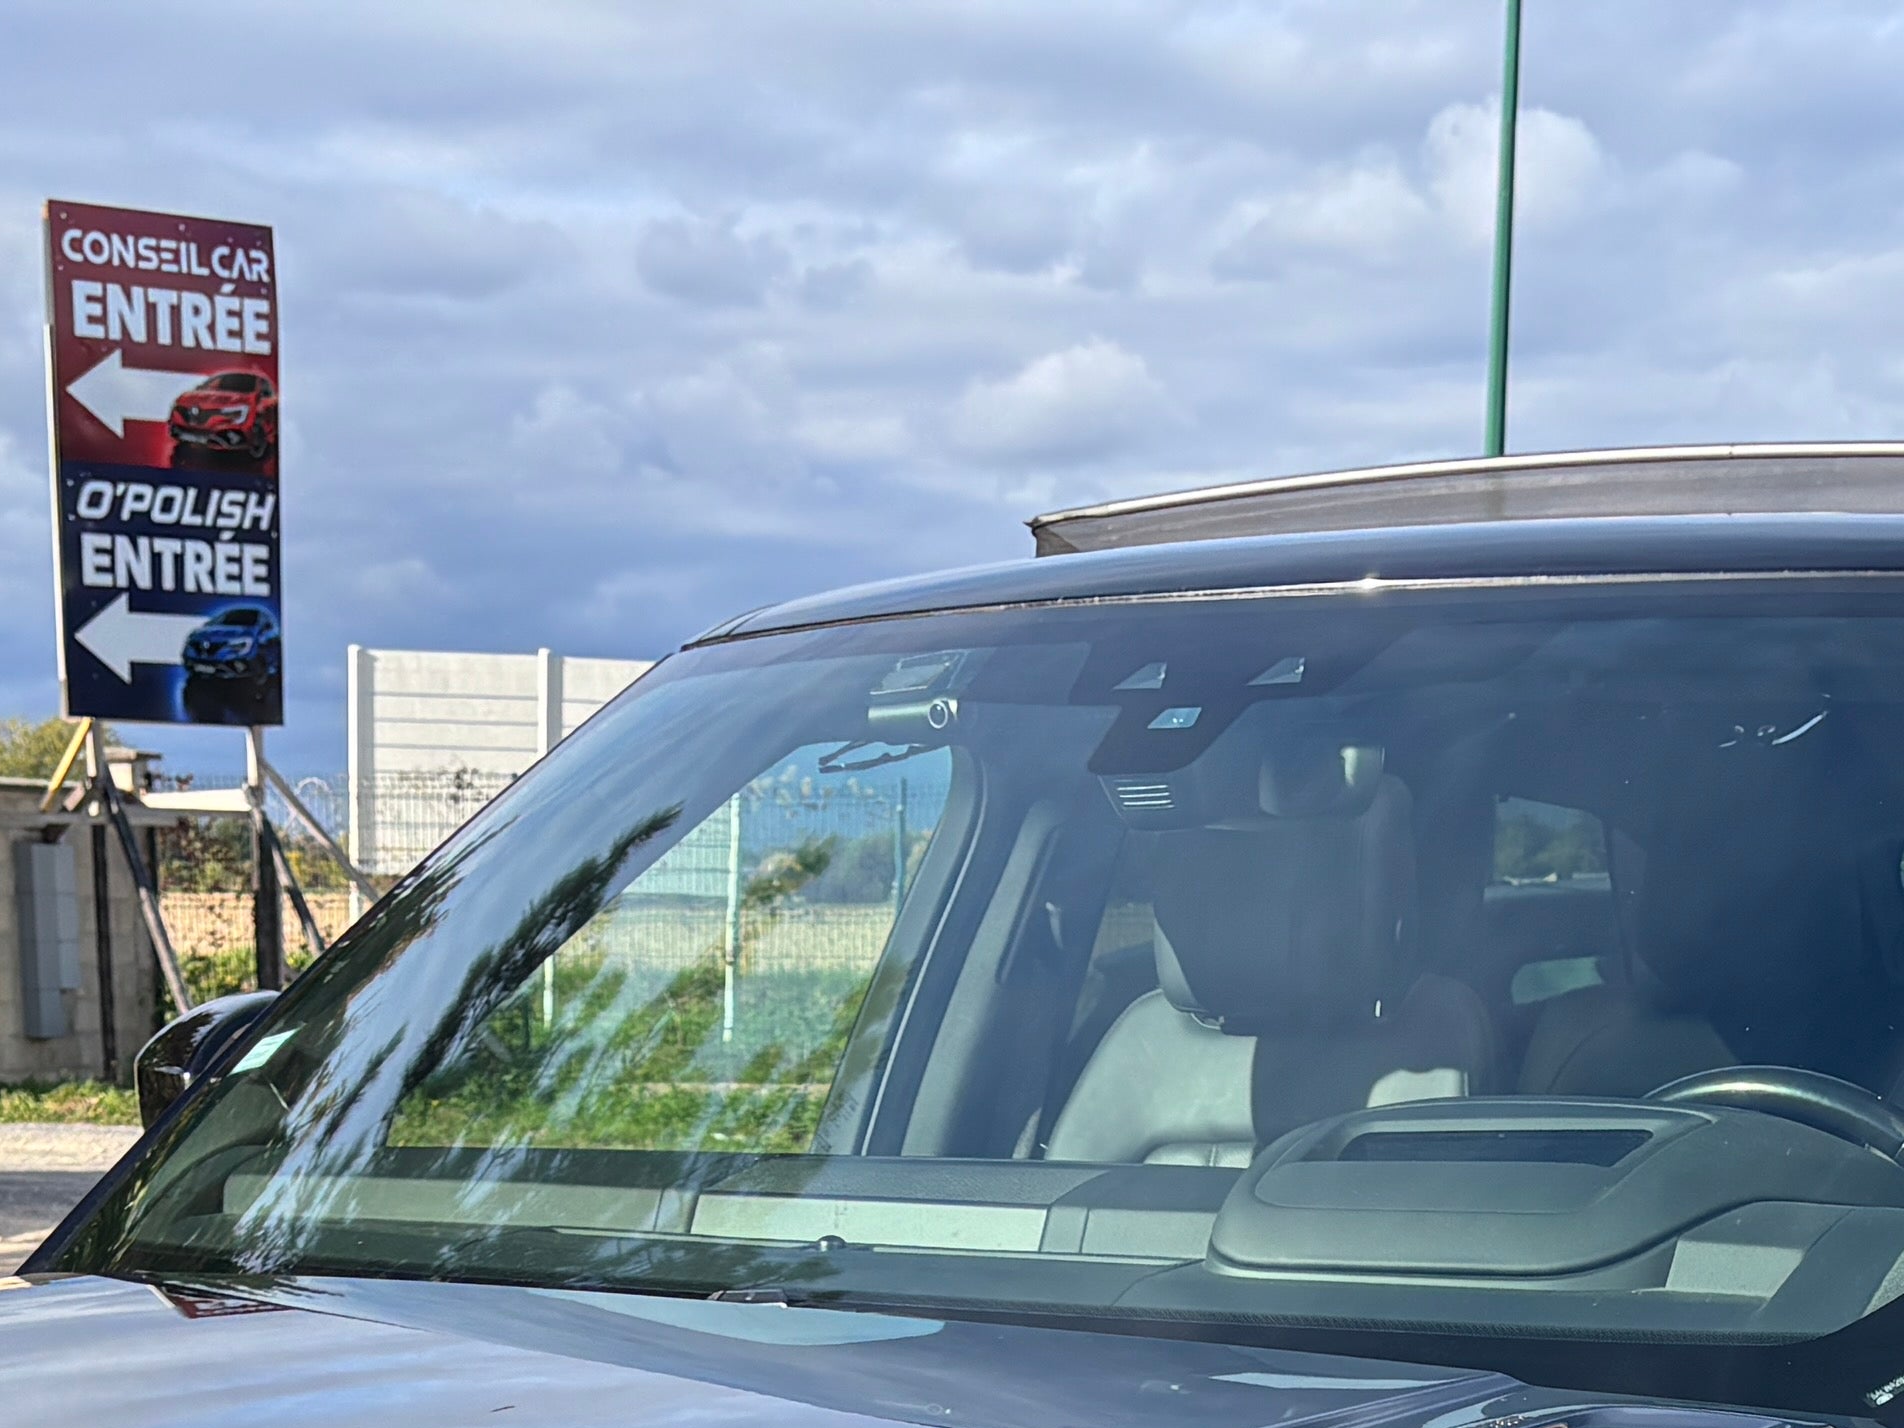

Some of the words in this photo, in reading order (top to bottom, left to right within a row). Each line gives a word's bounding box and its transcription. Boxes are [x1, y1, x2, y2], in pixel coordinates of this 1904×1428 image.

[71, 279, 272, 356] ENTRÉE
[76, 479, 276, 531] O'POLISH
[80, 531, 271, 597] ENTRÉE
